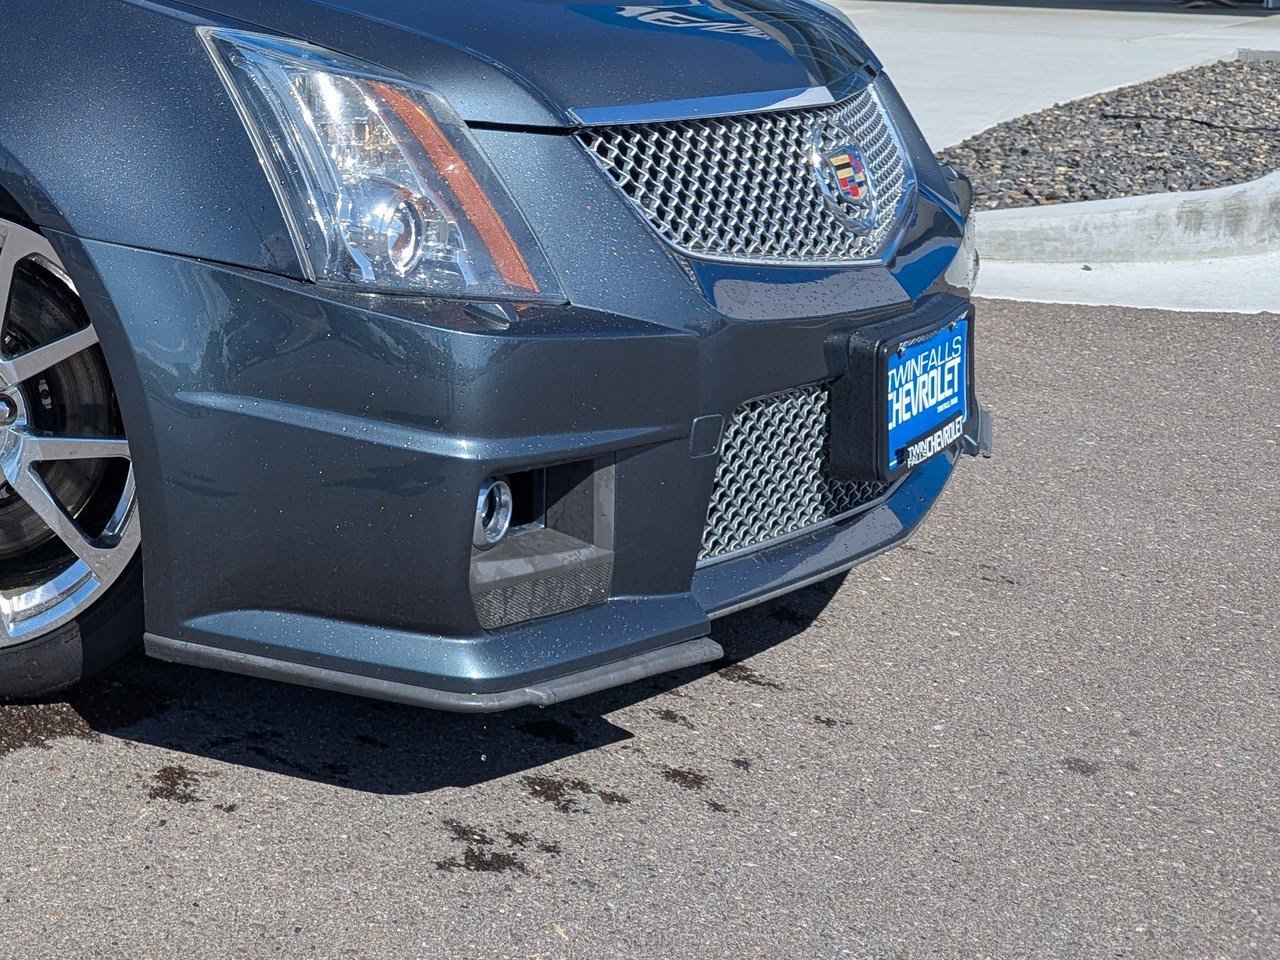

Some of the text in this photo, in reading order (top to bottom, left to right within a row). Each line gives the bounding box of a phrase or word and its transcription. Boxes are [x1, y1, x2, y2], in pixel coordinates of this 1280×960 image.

[888, 336, 962, 392] TWINFALLS
[888, 356, 961, 431] CHEVROLET
[907, 415, 964, 458] TWIN CHEVROLET
[907, 450, 928, 469] FALLS
